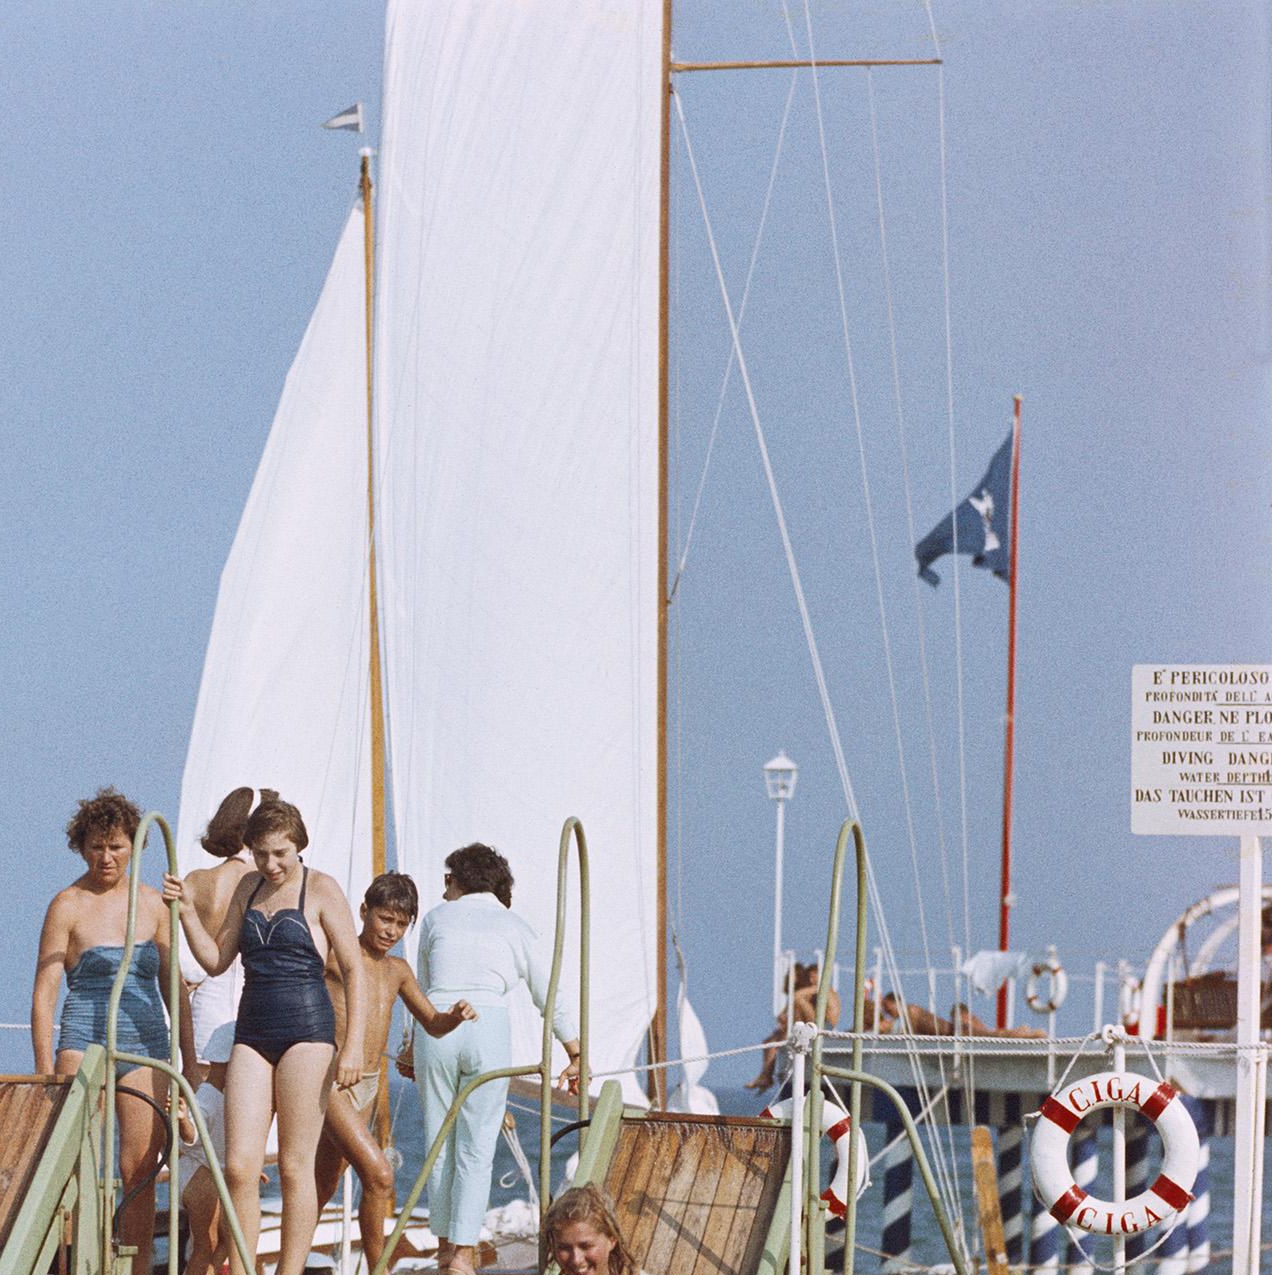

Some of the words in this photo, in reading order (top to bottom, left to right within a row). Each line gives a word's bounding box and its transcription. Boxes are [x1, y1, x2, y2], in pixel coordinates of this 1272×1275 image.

[1171, 671, 1269, 685] PERICOLOSO
[1153, 711, 1214, 724] DANGER
[1220, 711, 1239, 724] NE
[1137, 731, 1213, 742] PROFONDEUR
[1220, 731, 1235, 742] DE
[1162, 751, 1214, 765] DIVING
[1228, 752, 1272, 765] DANG
[1179, 772, 1220, 783] WATER
[1135, 789, 1162, 802] DAS
[1169, 789, 1233, 803] TAUCHEN
[1240, 790, 1265, 803] IST
